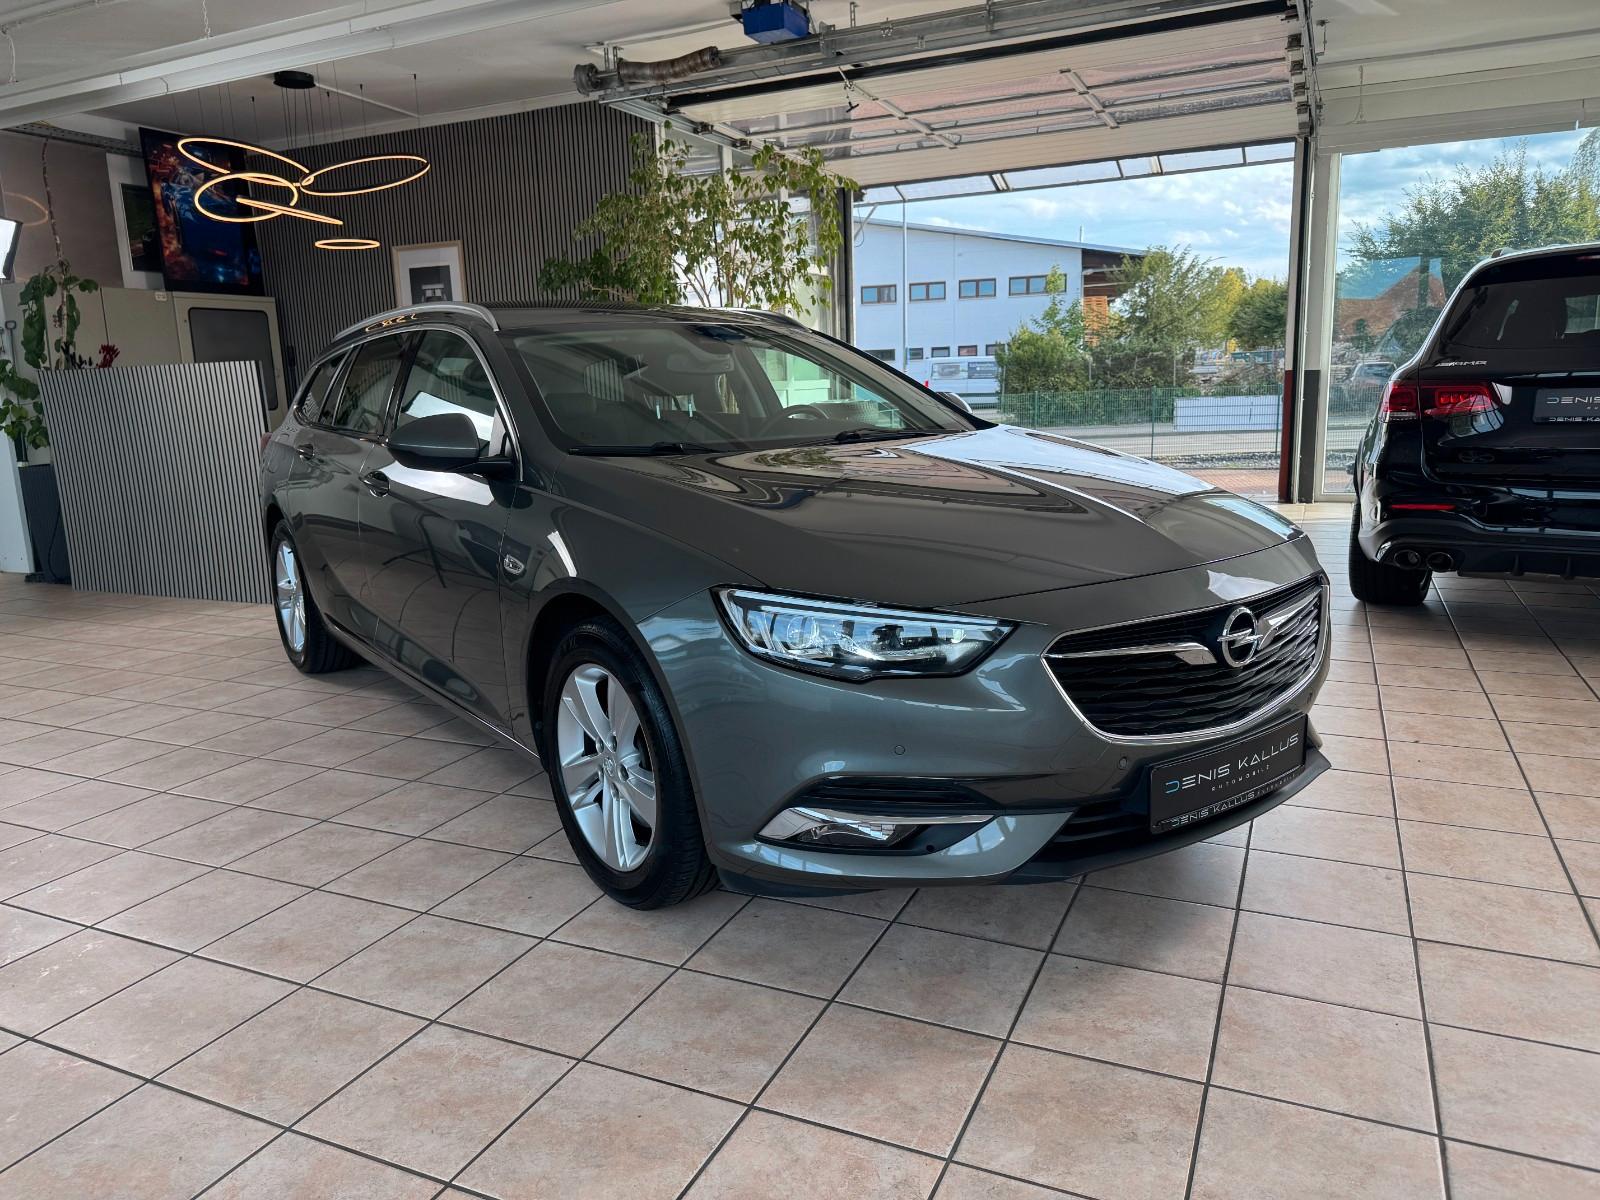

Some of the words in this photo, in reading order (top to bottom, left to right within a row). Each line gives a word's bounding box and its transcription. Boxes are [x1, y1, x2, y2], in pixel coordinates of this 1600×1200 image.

[1164, 763, 1231, 794] DENIS
[1238, 732, 1299, 770] KALLUS
[1170, 808, 1209, 827] DENIS
[1213, 791, 1255, 814] KALLUS
